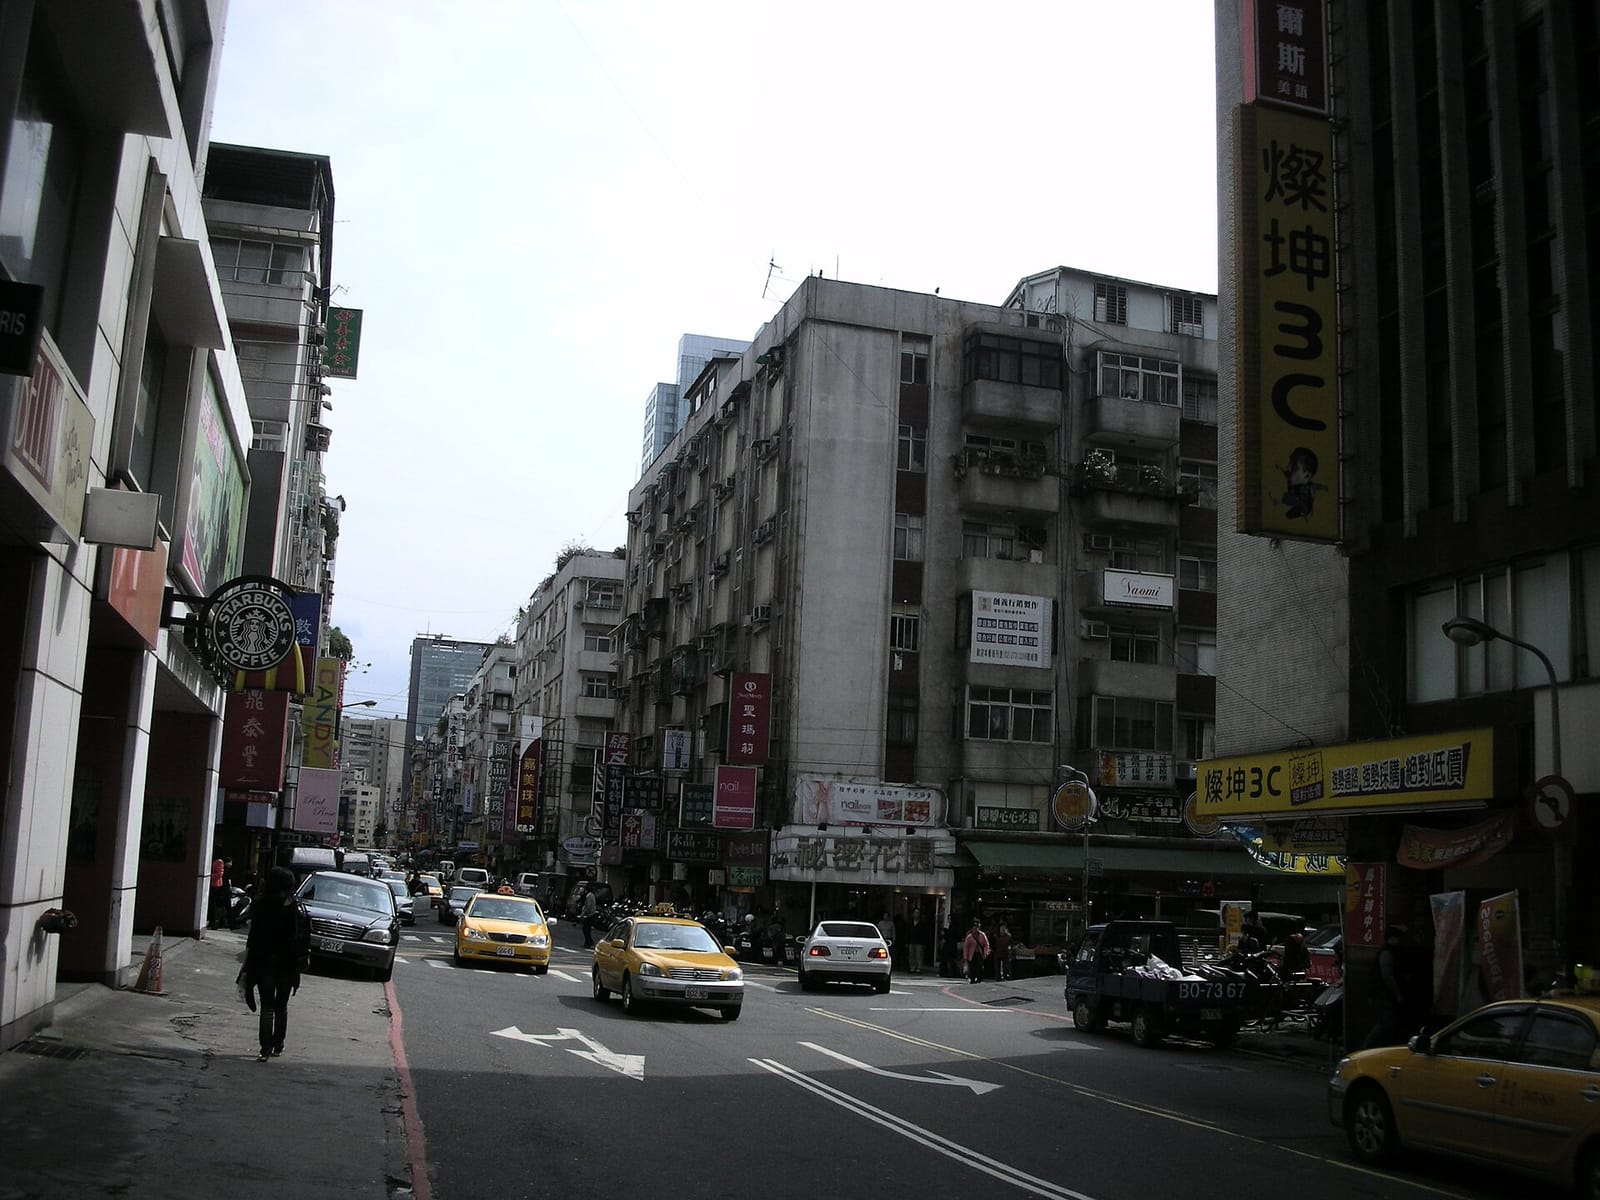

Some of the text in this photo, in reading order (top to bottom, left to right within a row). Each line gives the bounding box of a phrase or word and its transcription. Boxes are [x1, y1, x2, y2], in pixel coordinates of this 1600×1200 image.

[1277, 4, 1305, 77] 爾斯
[1262, 140, 1331, 432] 燦坤3C
[1120, 576, 1161, 596] Naomi
[219, 593, 292, 632] STARBUCKS
[222, 642, 280, 666] COFFEE
[312, 669, 336, 759] CANDY
[1204, 765, 1281, 804] 燦坤3C
[1291, 758, 1320, 787] 燦坤
[1404, 745, 1464, 788] 絕對低價
[719, 781, 740, 792] nail
